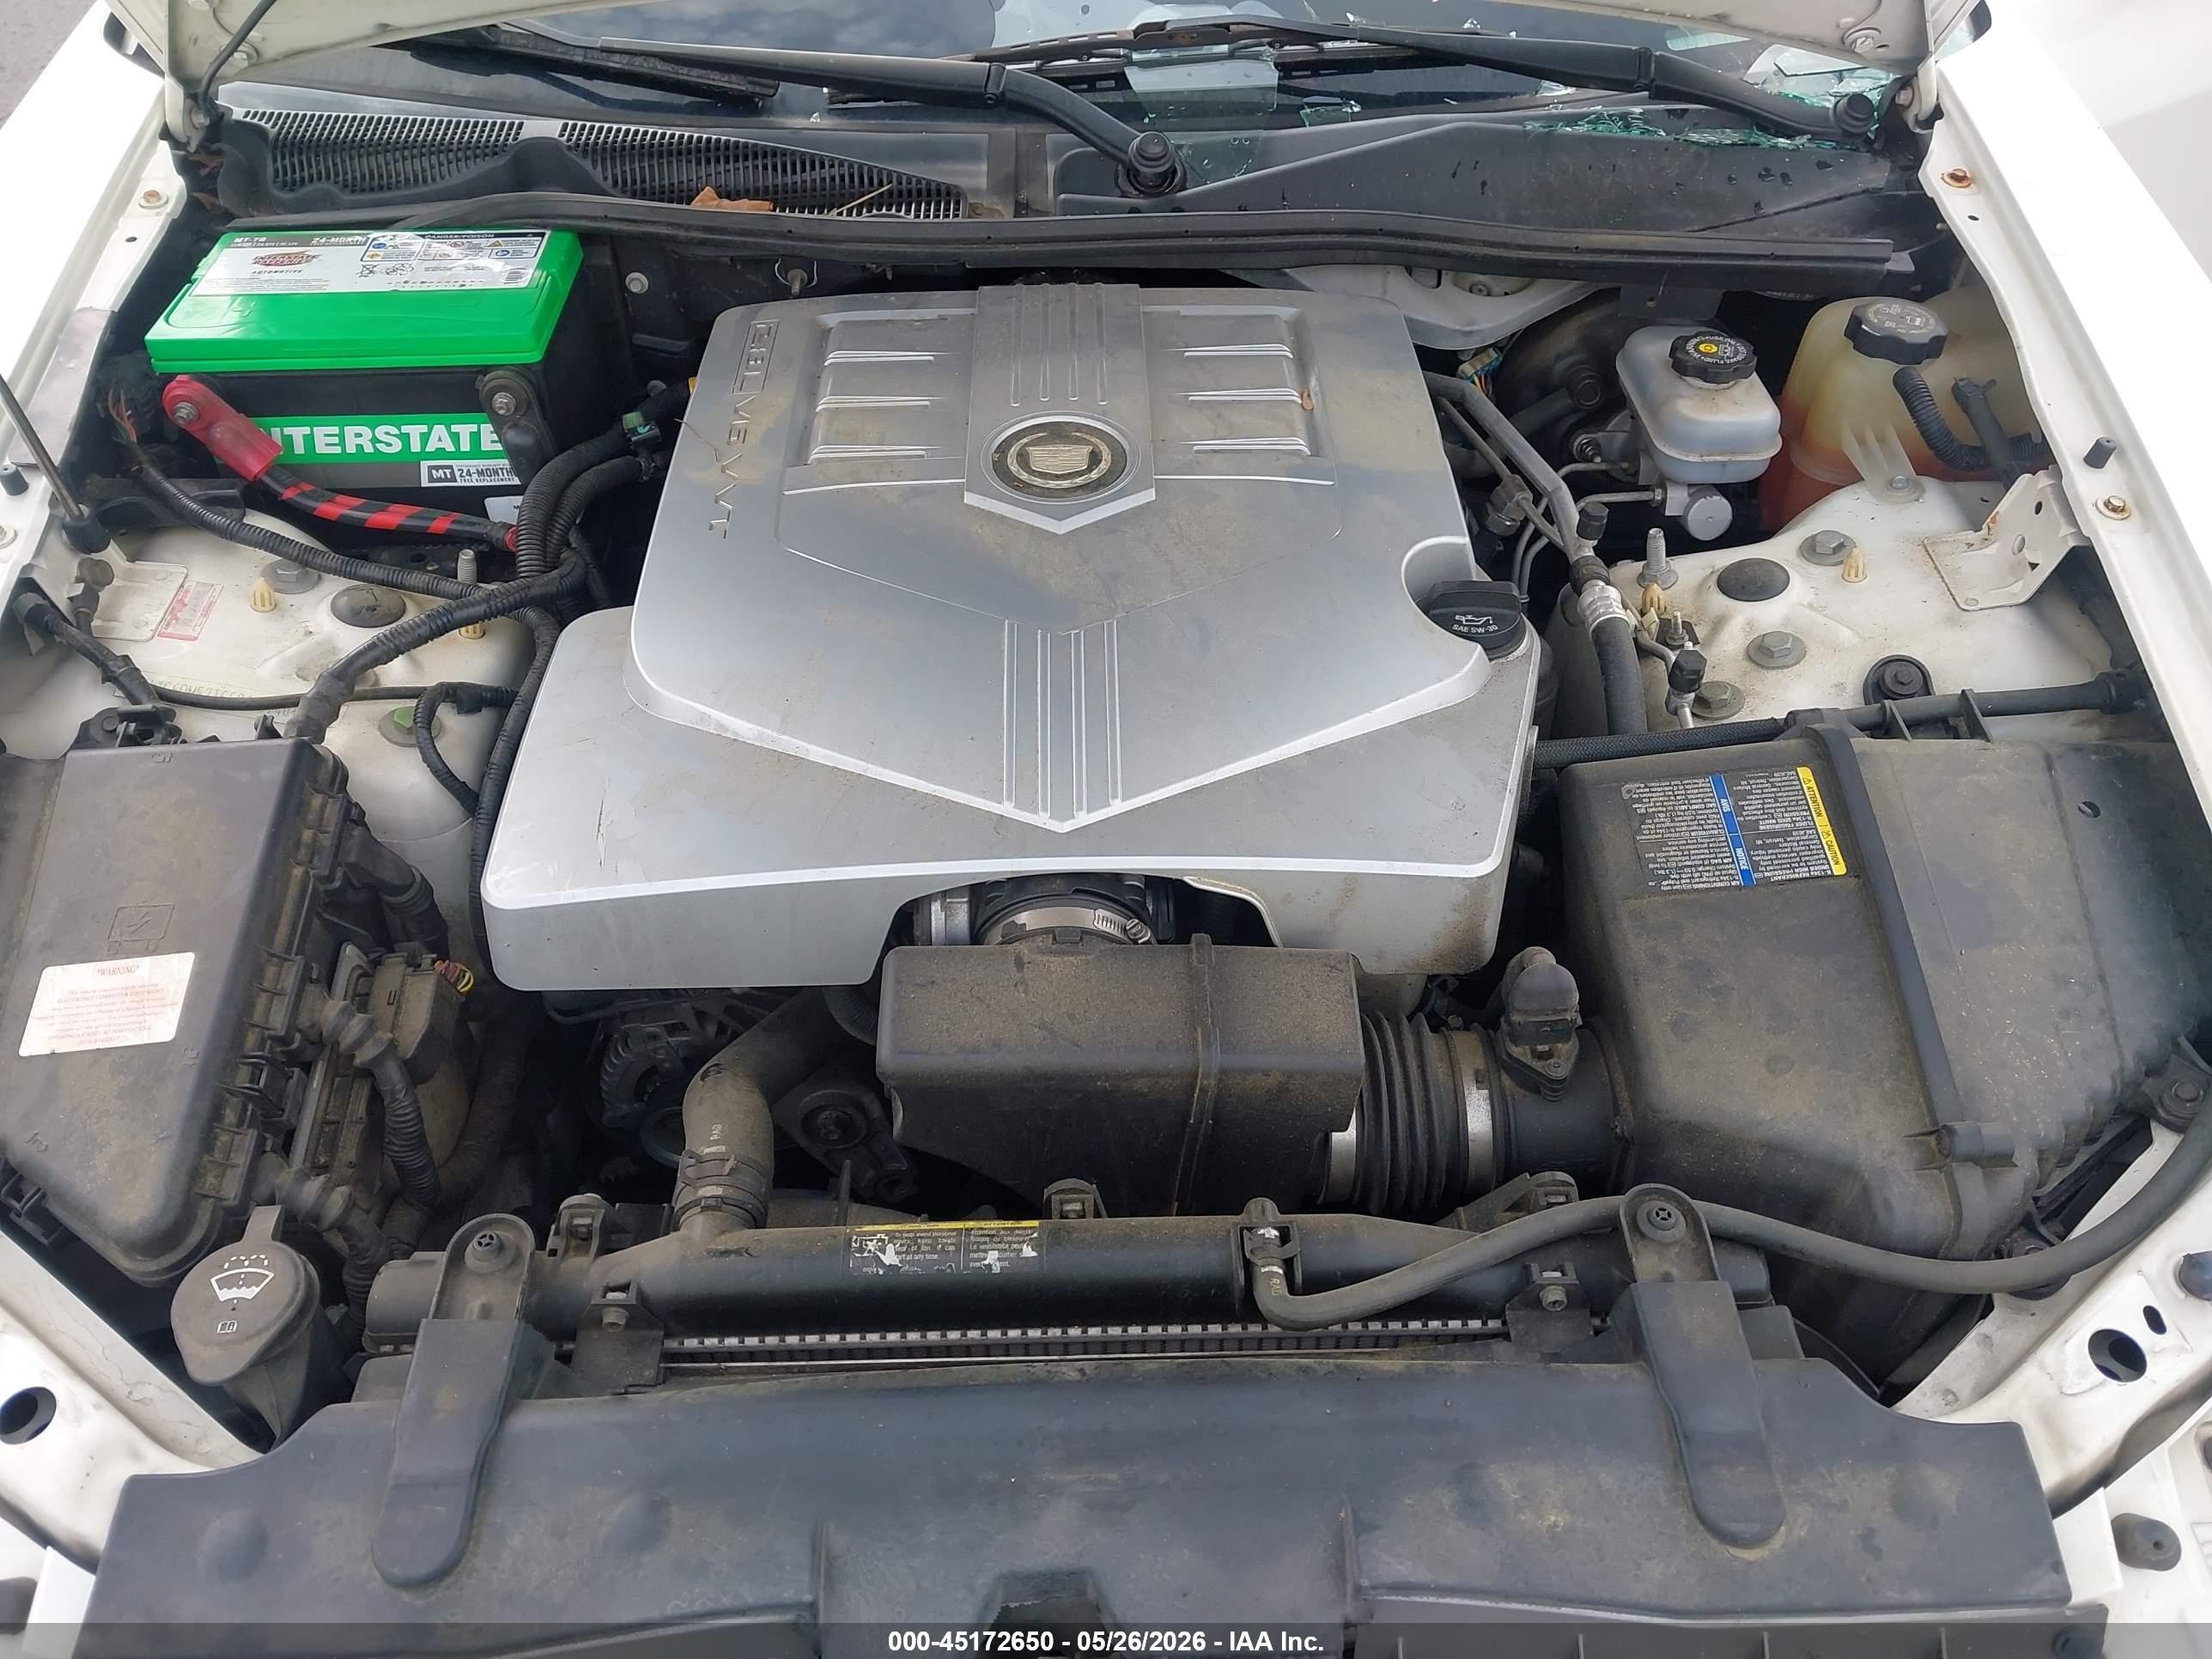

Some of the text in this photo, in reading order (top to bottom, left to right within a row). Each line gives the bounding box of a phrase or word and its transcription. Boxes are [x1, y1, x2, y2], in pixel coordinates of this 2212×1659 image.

[270, 424, 503, 455] TERSTATE
[431, 469, 452, 479] MT
[1452, 623, 1498, 634] SAE 5W-30
[1720, 799, 1731, 812] AVIS
[1807, 786, 1824, 817] ATTENTION
[1735, 848, 1749, 871] NOTICE
[1826, 840, 1840, 866] CAUTION
